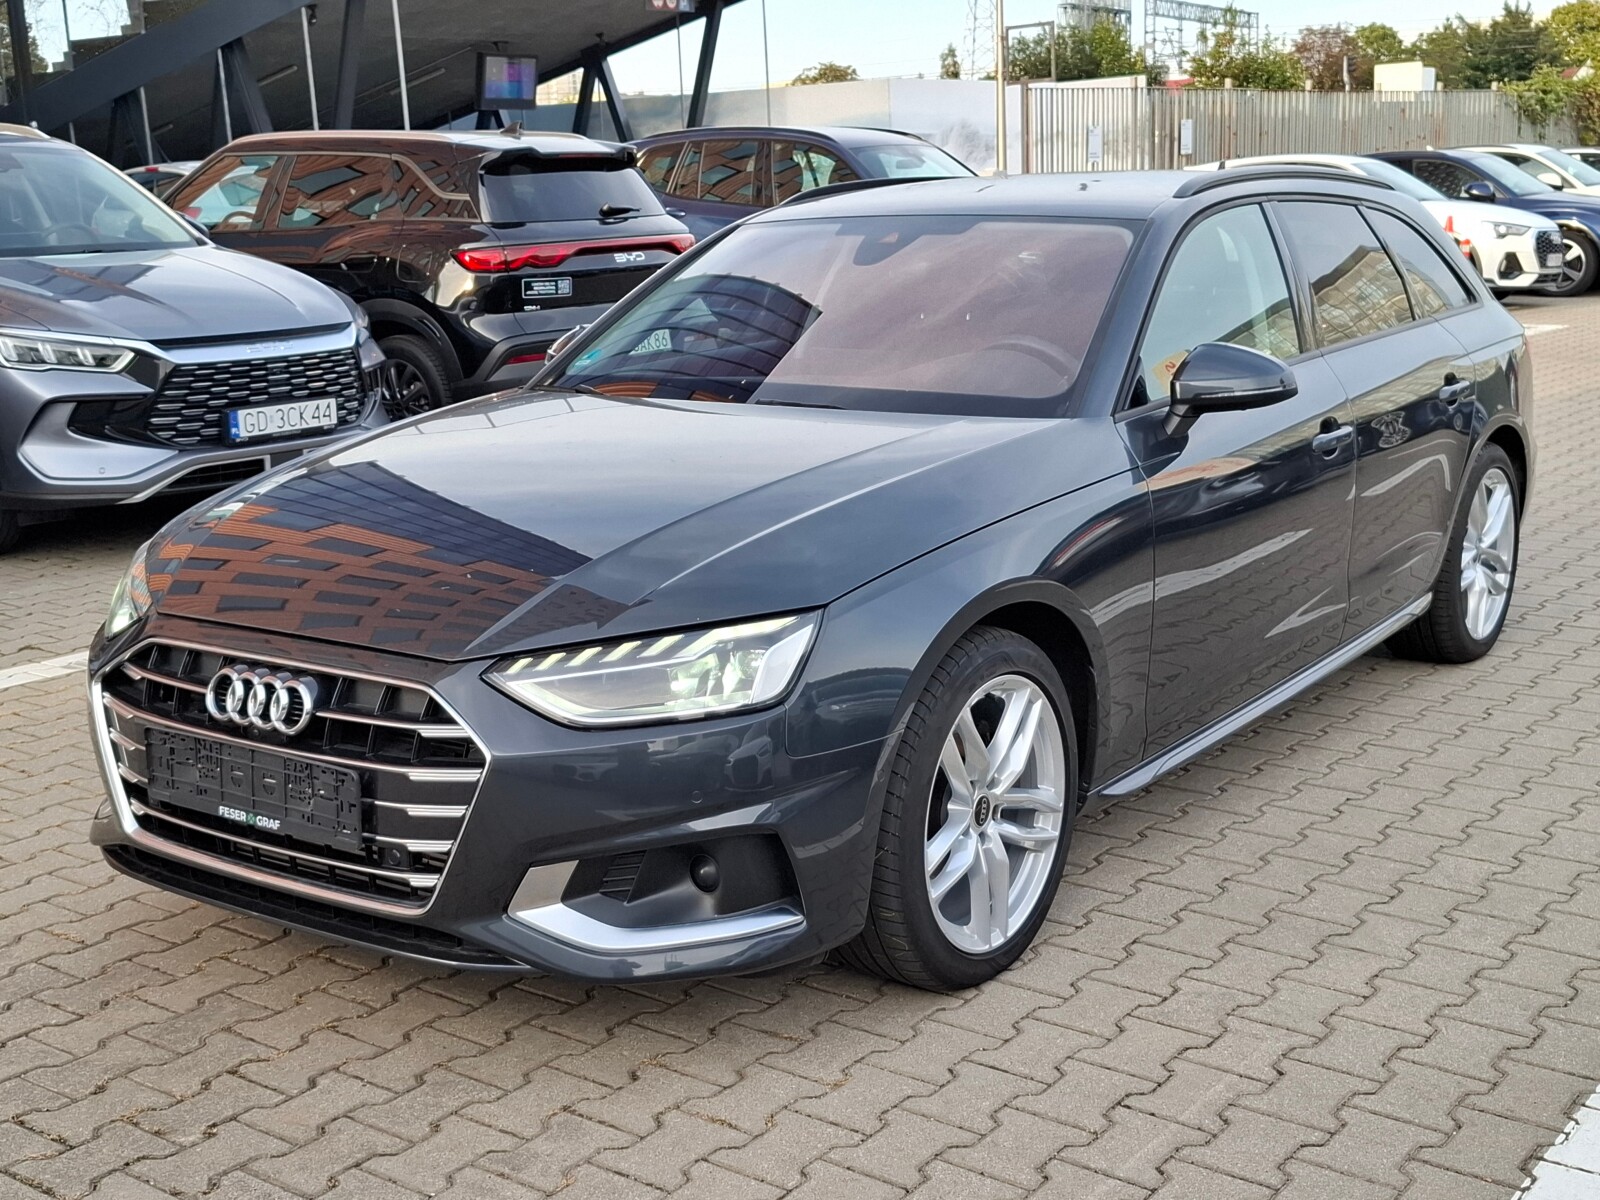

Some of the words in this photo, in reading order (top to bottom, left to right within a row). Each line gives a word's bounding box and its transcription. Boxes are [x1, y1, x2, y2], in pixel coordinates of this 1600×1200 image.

[613, 252, 646, 263] BYD
[243, 410, 269, 434] GD
[275, 402, 332, 429] 3CK44
[218, 805, 247, 822] FESER
[256, 815, 281, 830] GRAF
